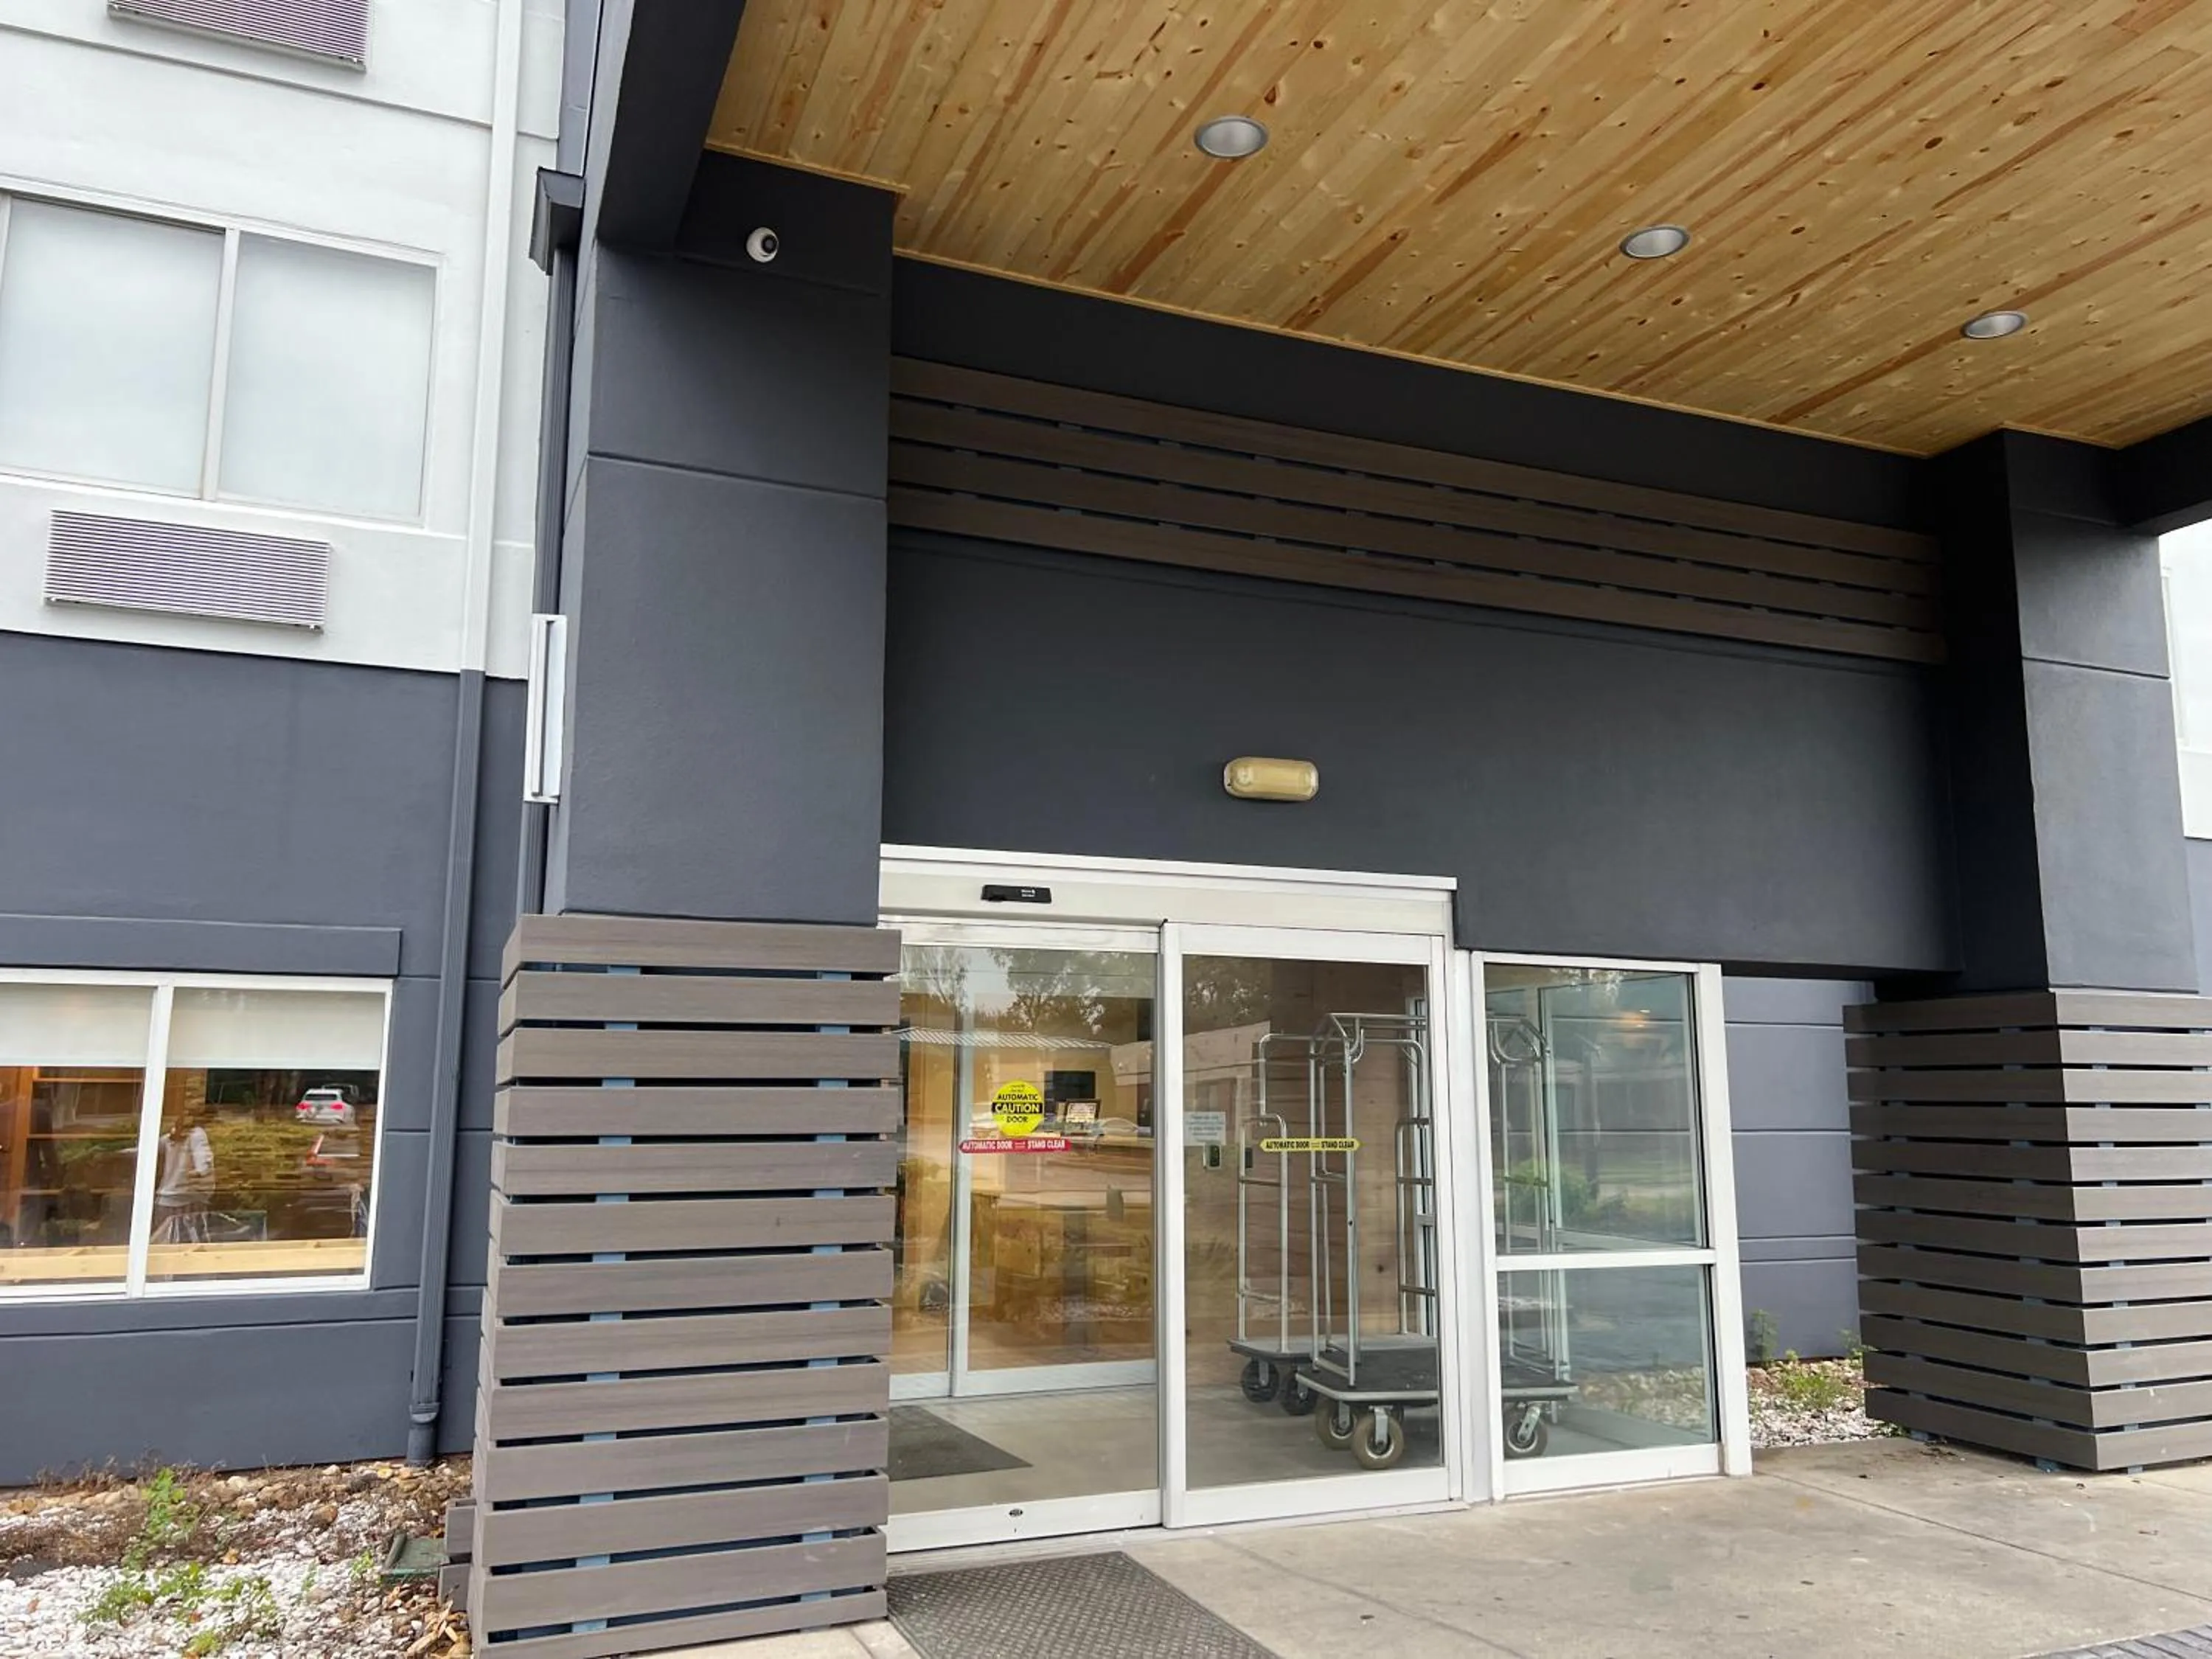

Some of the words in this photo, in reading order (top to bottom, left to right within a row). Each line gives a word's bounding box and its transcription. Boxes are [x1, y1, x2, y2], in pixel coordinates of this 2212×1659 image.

[995, 1104, 1040, 1113] CAUTION
[962, 1141, 995, 1150] AUTOMATIC
[996, 1141, 1013, 1150] DOOR
[1027, 1141, 1046, 1150] STAND
[1046, 1140, 1065, 1149] CLEAR
